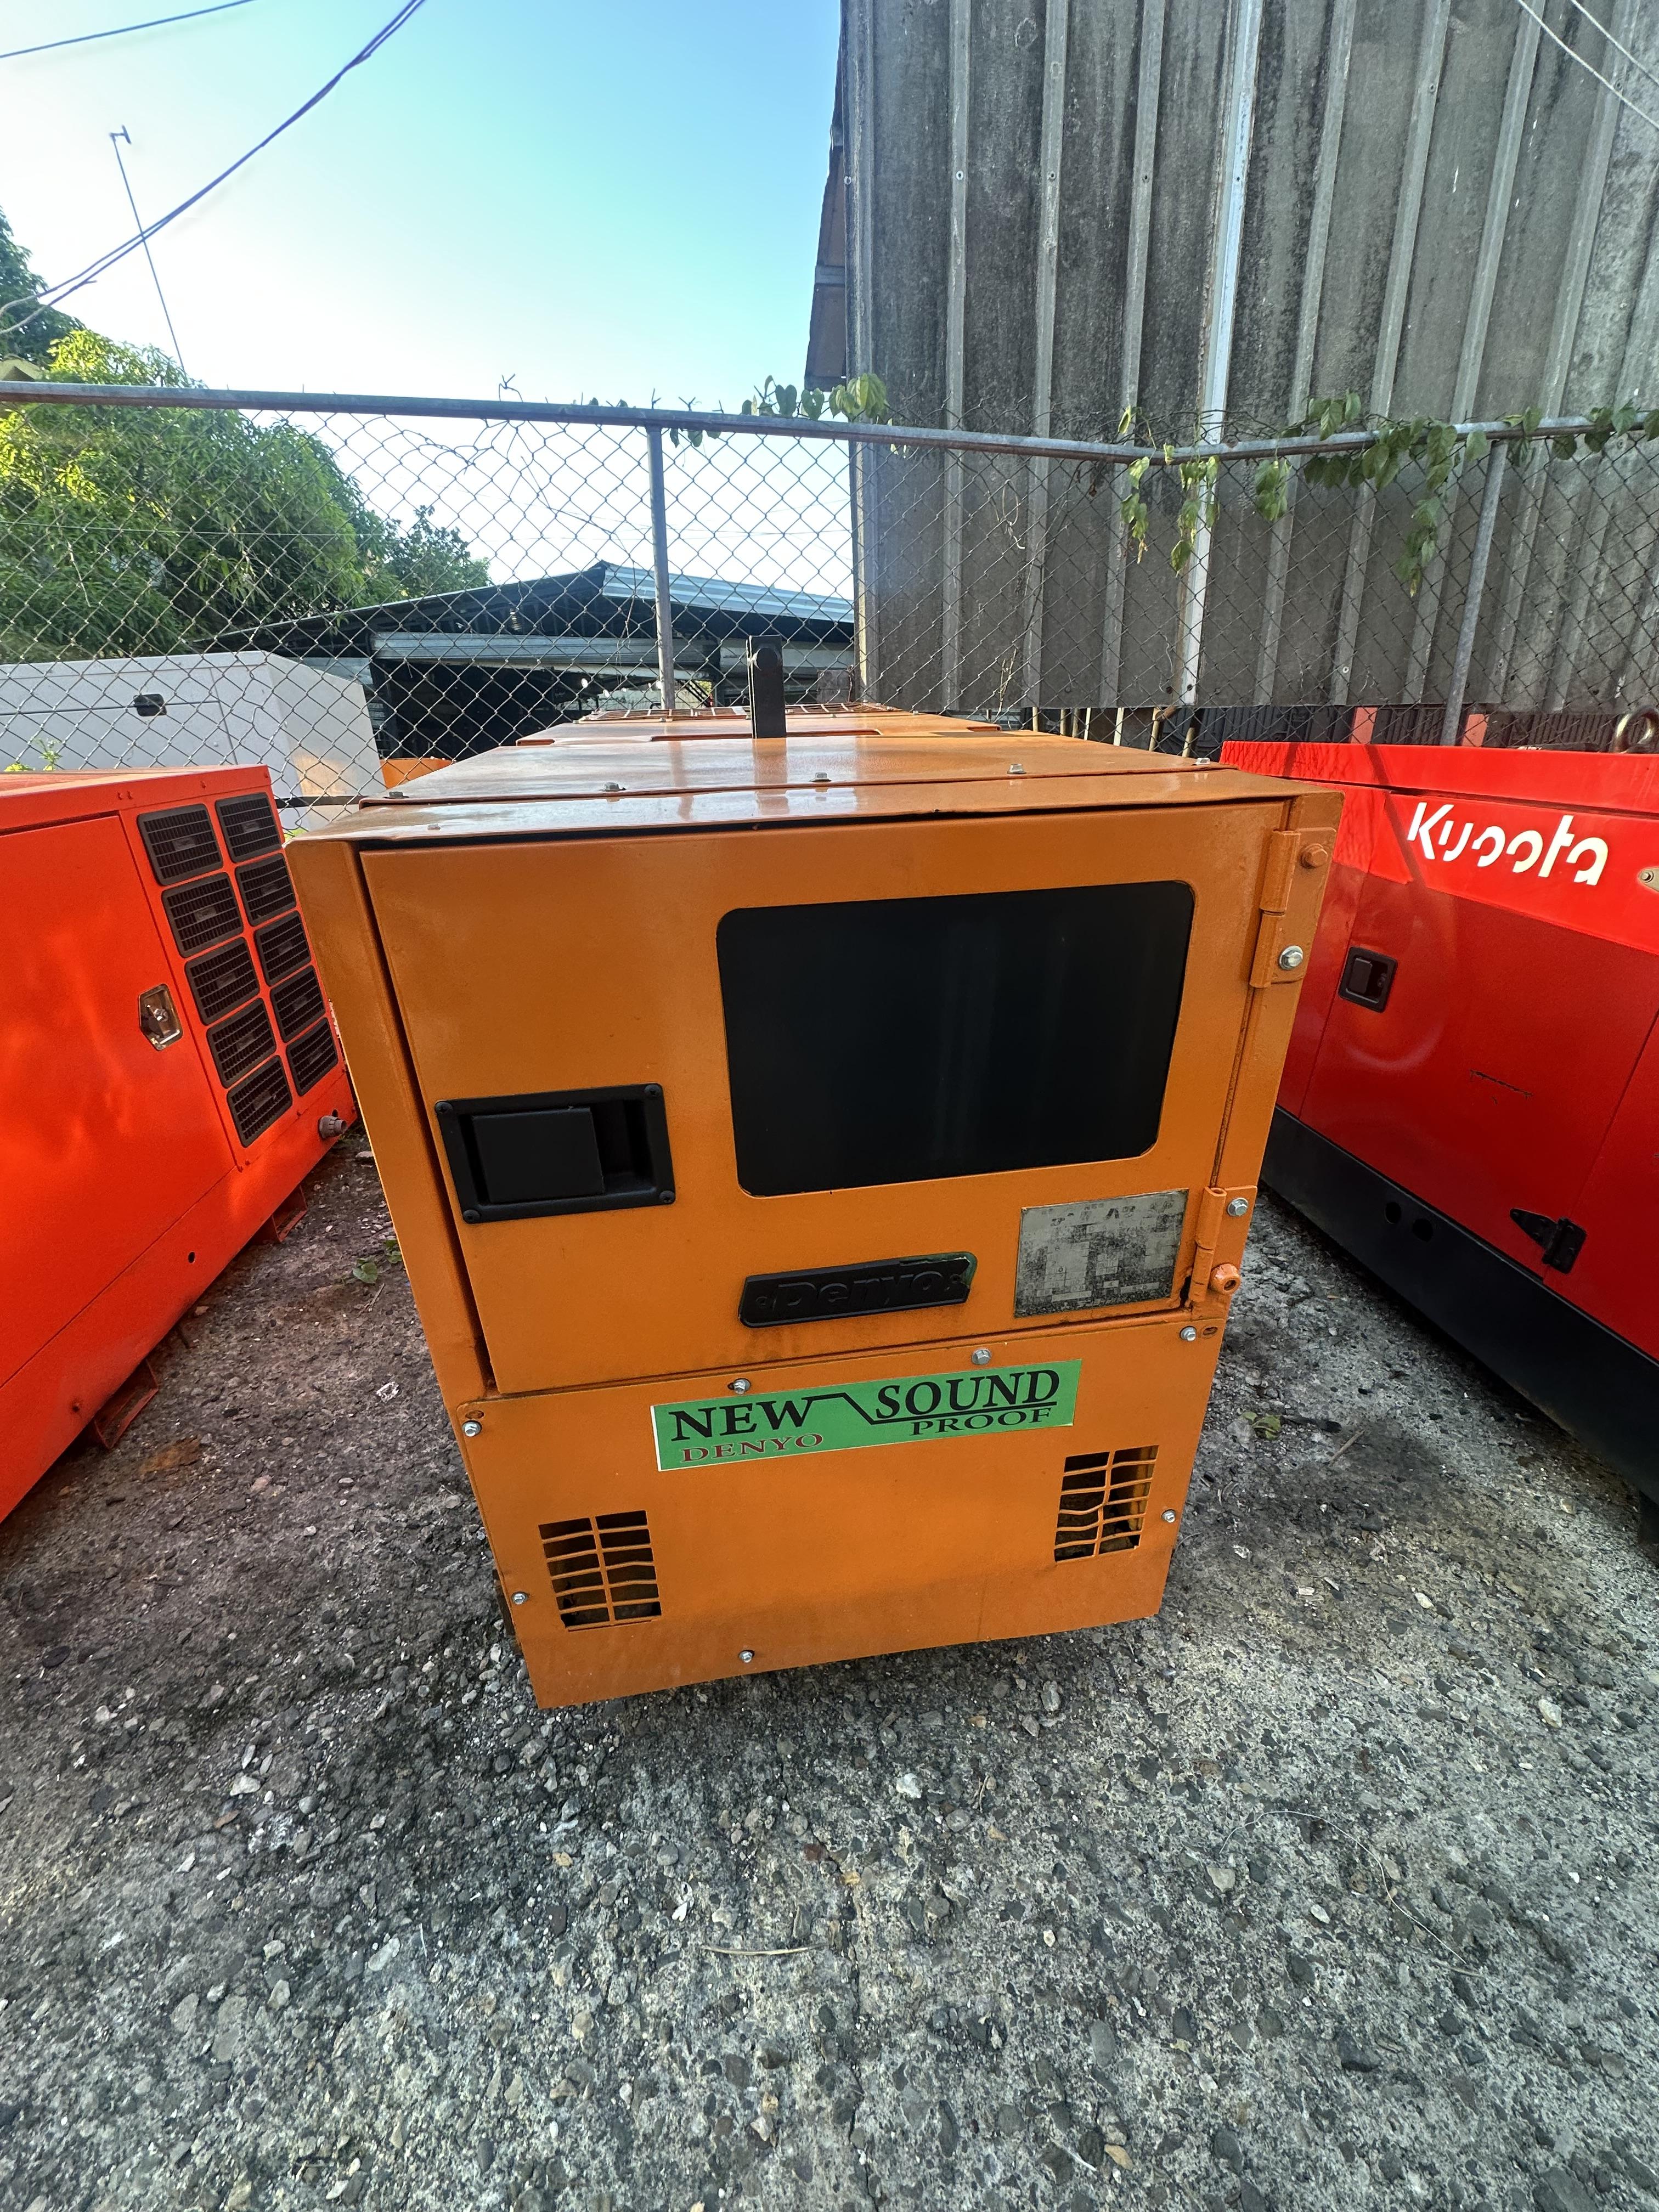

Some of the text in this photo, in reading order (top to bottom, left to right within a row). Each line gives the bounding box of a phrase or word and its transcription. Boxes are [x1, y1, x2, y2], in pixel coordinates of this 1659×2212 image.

[668, 1369, 1060, 1442] NEW SOUND
[910, 1407, 1052, 1436] PROOF
[682, 1432, 823, 1463] DENYO
